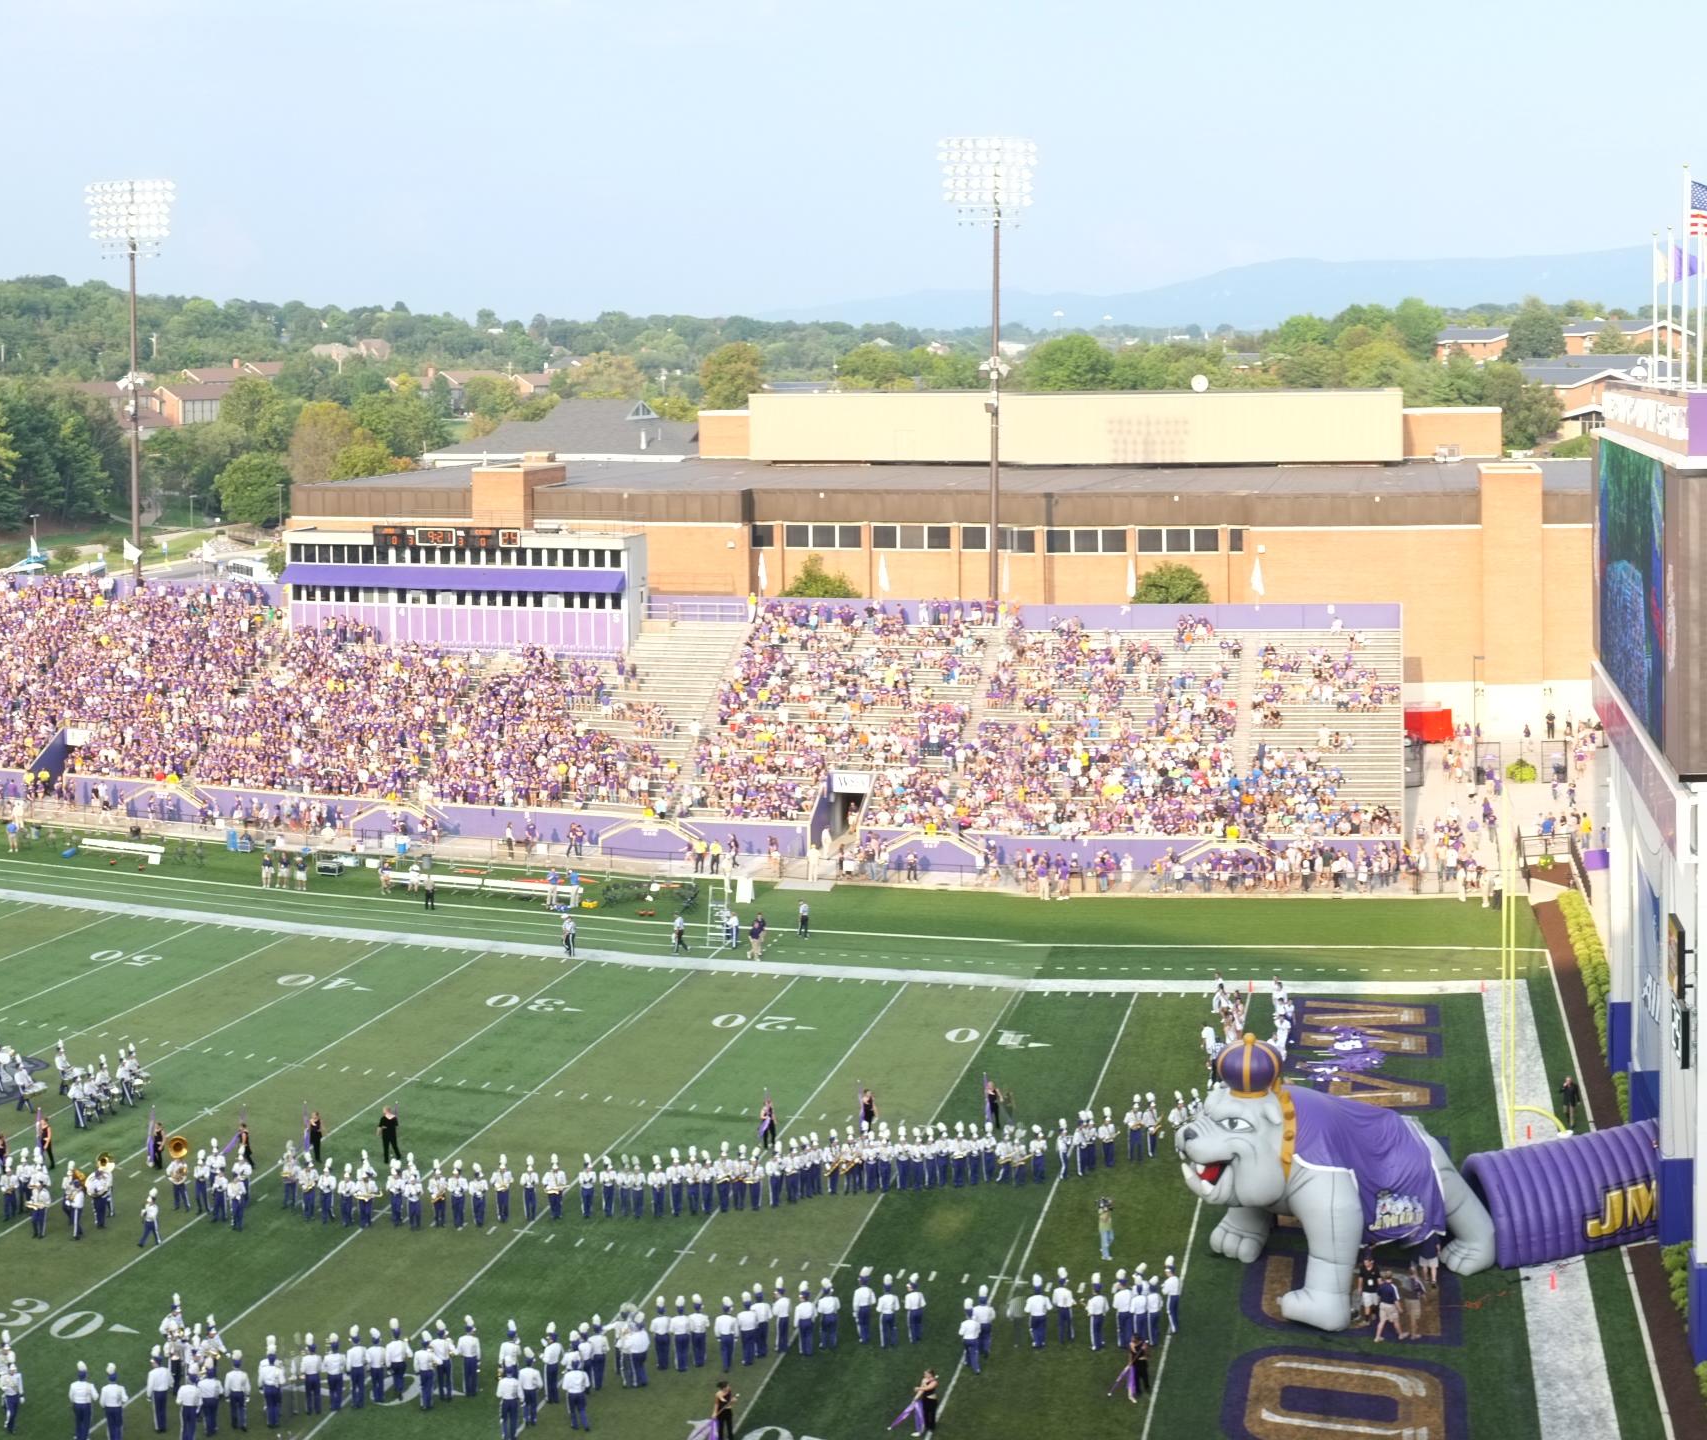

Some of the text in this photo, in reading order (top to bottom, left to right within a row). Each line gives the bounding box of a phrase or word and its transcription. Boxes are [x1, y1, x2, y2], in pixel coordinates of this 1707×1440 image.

[89, 950, 163, 967] 50
[277, 974, 356, 990] 40
[485, 994, 566, 1012] 30
[711, 1014, 797, 1031] 20
